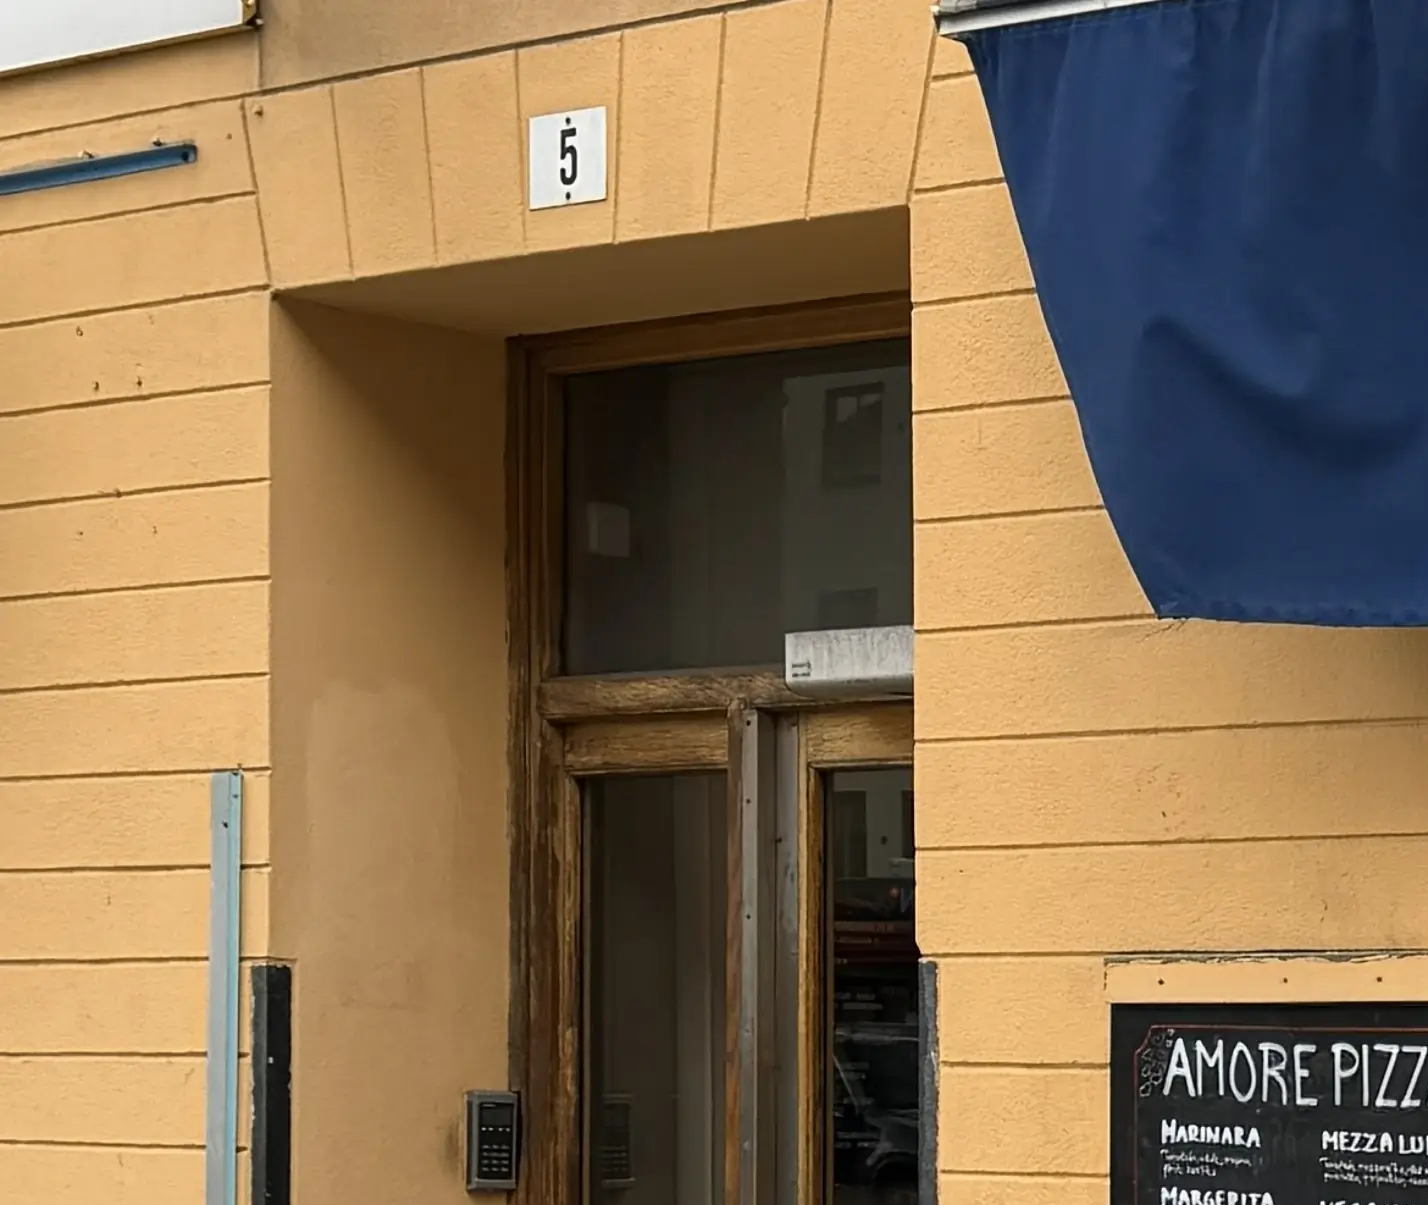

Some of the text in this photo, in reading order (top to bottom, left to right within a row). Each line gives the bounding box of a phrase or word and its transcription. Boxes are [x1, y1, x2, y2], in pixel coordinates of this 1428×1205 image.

[560, 128, 577, 186] 5
[1162, 1037, 1319, 1107] AMORE
[1321, 1130, 1393, 1154] MEZZA
